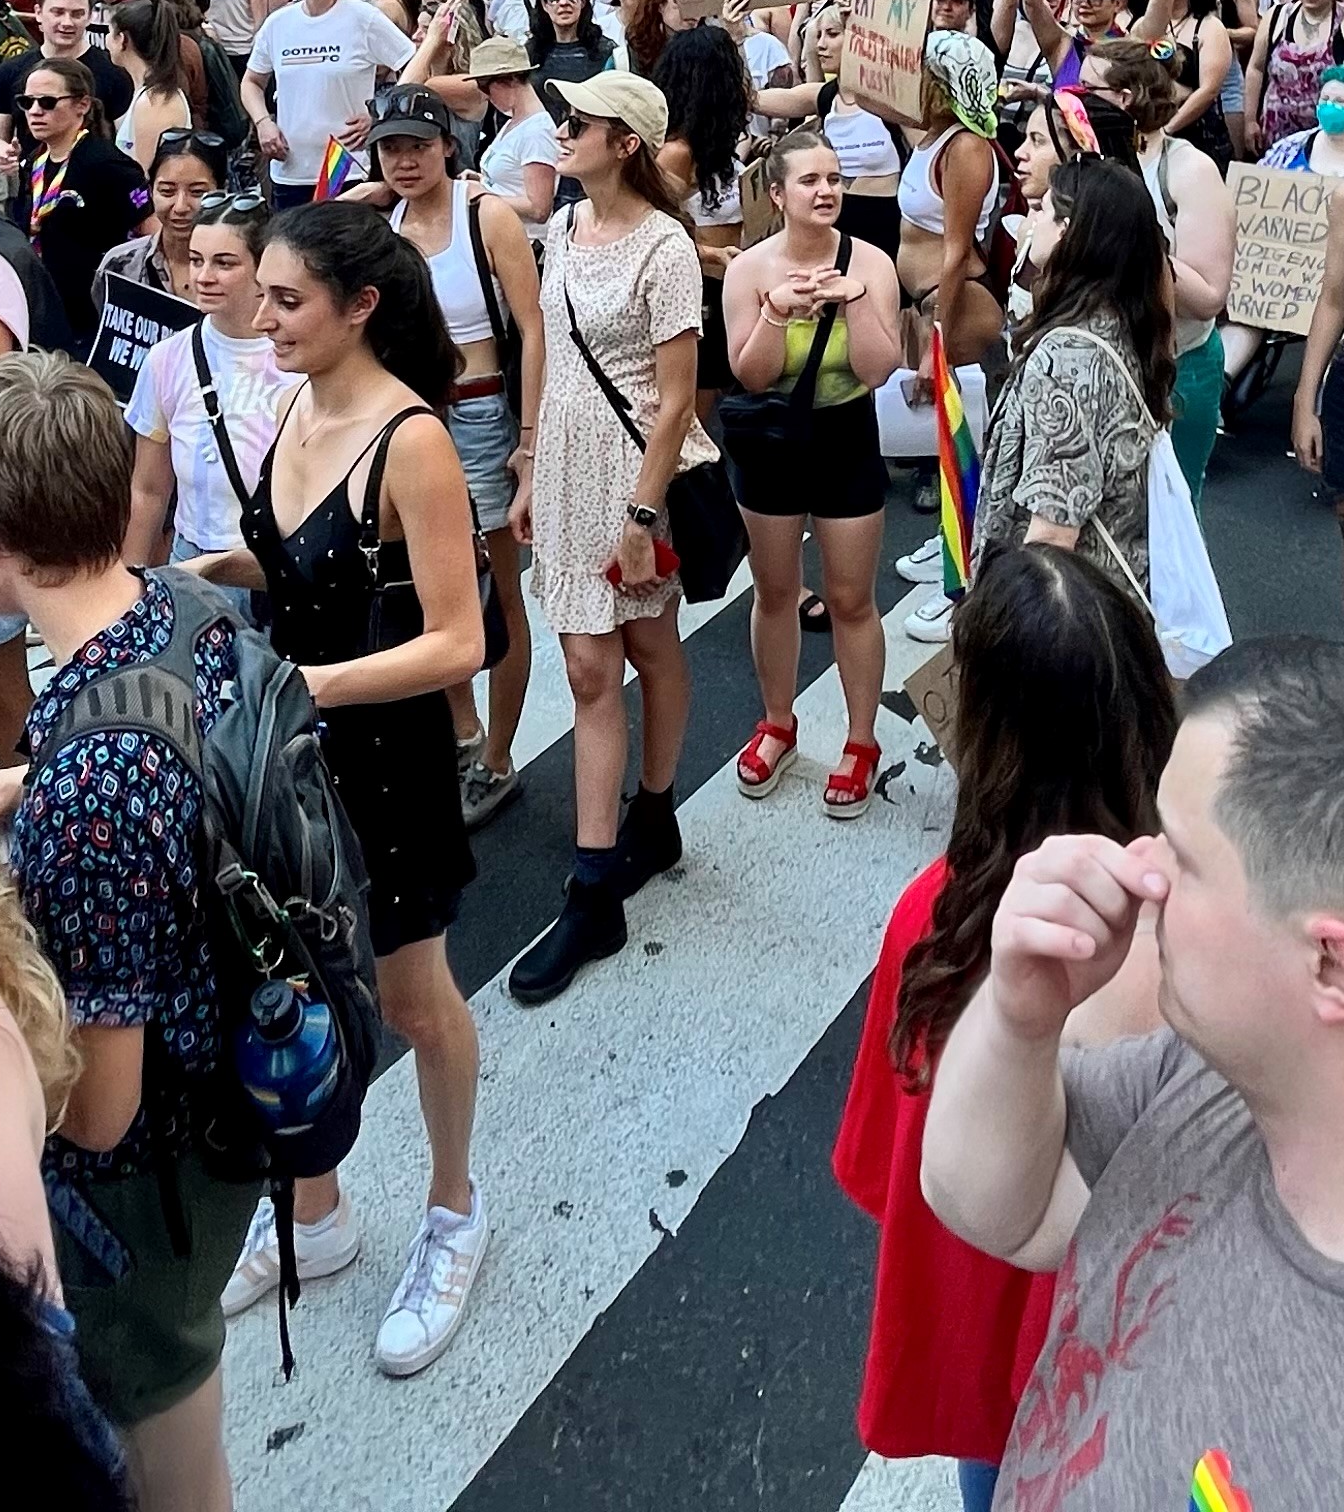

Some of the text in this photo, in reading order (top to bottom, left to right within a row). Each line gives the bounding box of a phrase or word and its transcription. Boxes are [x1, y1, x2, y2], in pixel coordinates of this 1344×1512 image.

[282, 45, 341, 57] GOTHAM
[1235, 175, 1335, 215] BLACK
[1235, 258, 1292, 279] OMEN
[1252, 277, 1318, 303] WOMEN
[1227, 292, 1300, 320] ARNED
[105, 302, 135, 336] TAKE
[134, 315, 160, 346] OUR
[108, 336, 133, 366] WE
